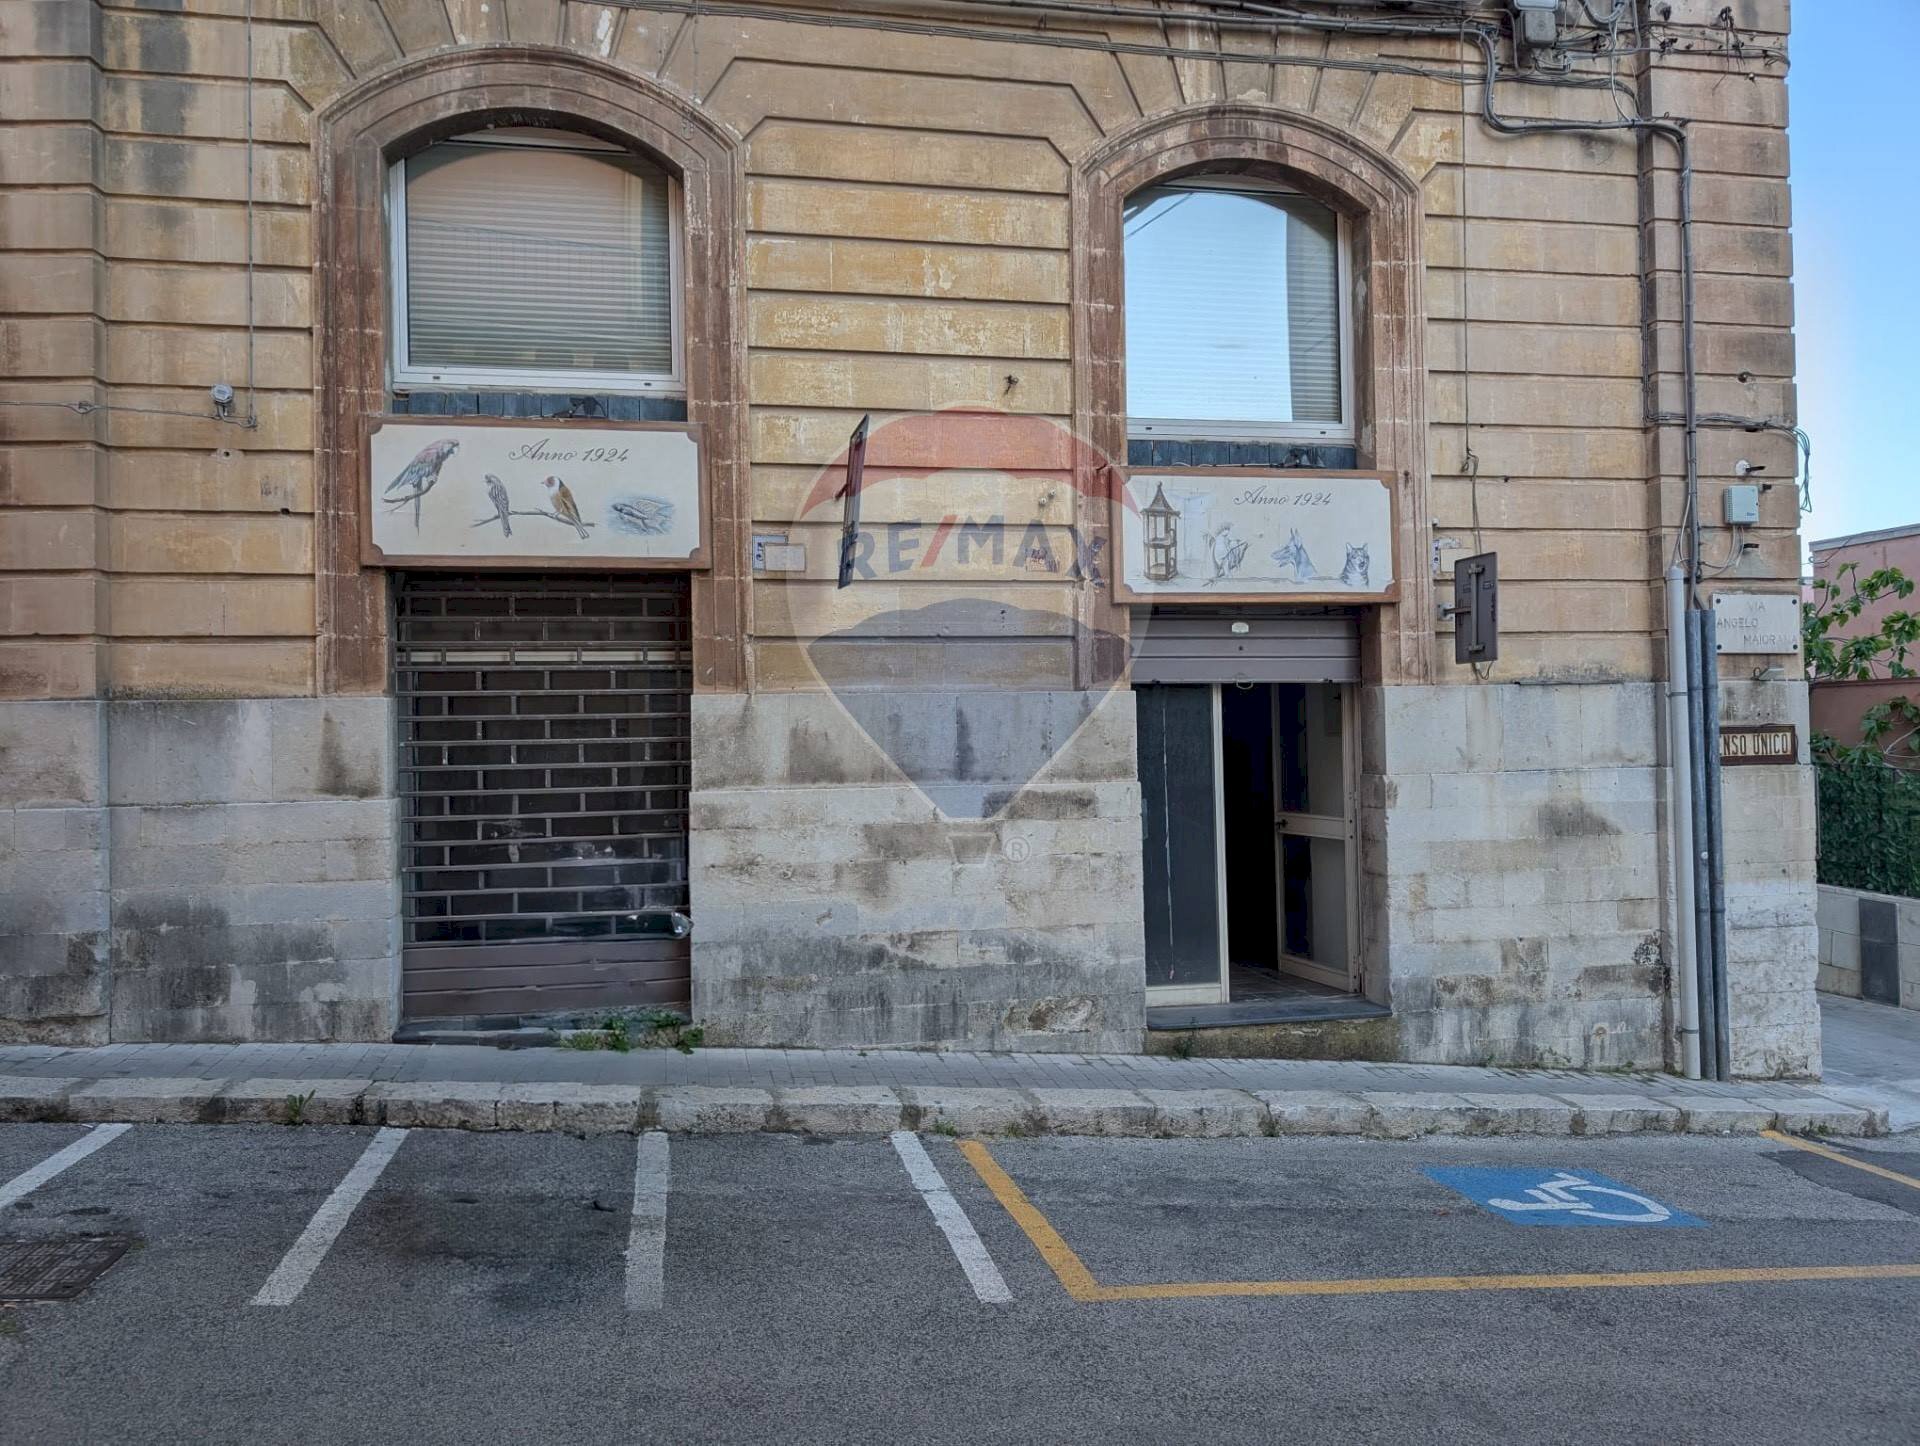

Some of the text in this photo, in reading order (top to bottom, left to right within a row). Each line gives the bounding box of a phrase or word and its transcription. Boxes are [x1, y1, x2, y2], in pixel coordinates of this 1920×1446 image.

[508, 438, 630, 464] Anno 1924
[1233, 485, 1332, 507] Anno 1924
[1747, 600, 1765, 612] VIA
[1717, 617, 1759, 629] ANGELO
[1753, 733, 1788, 755] UNICO
